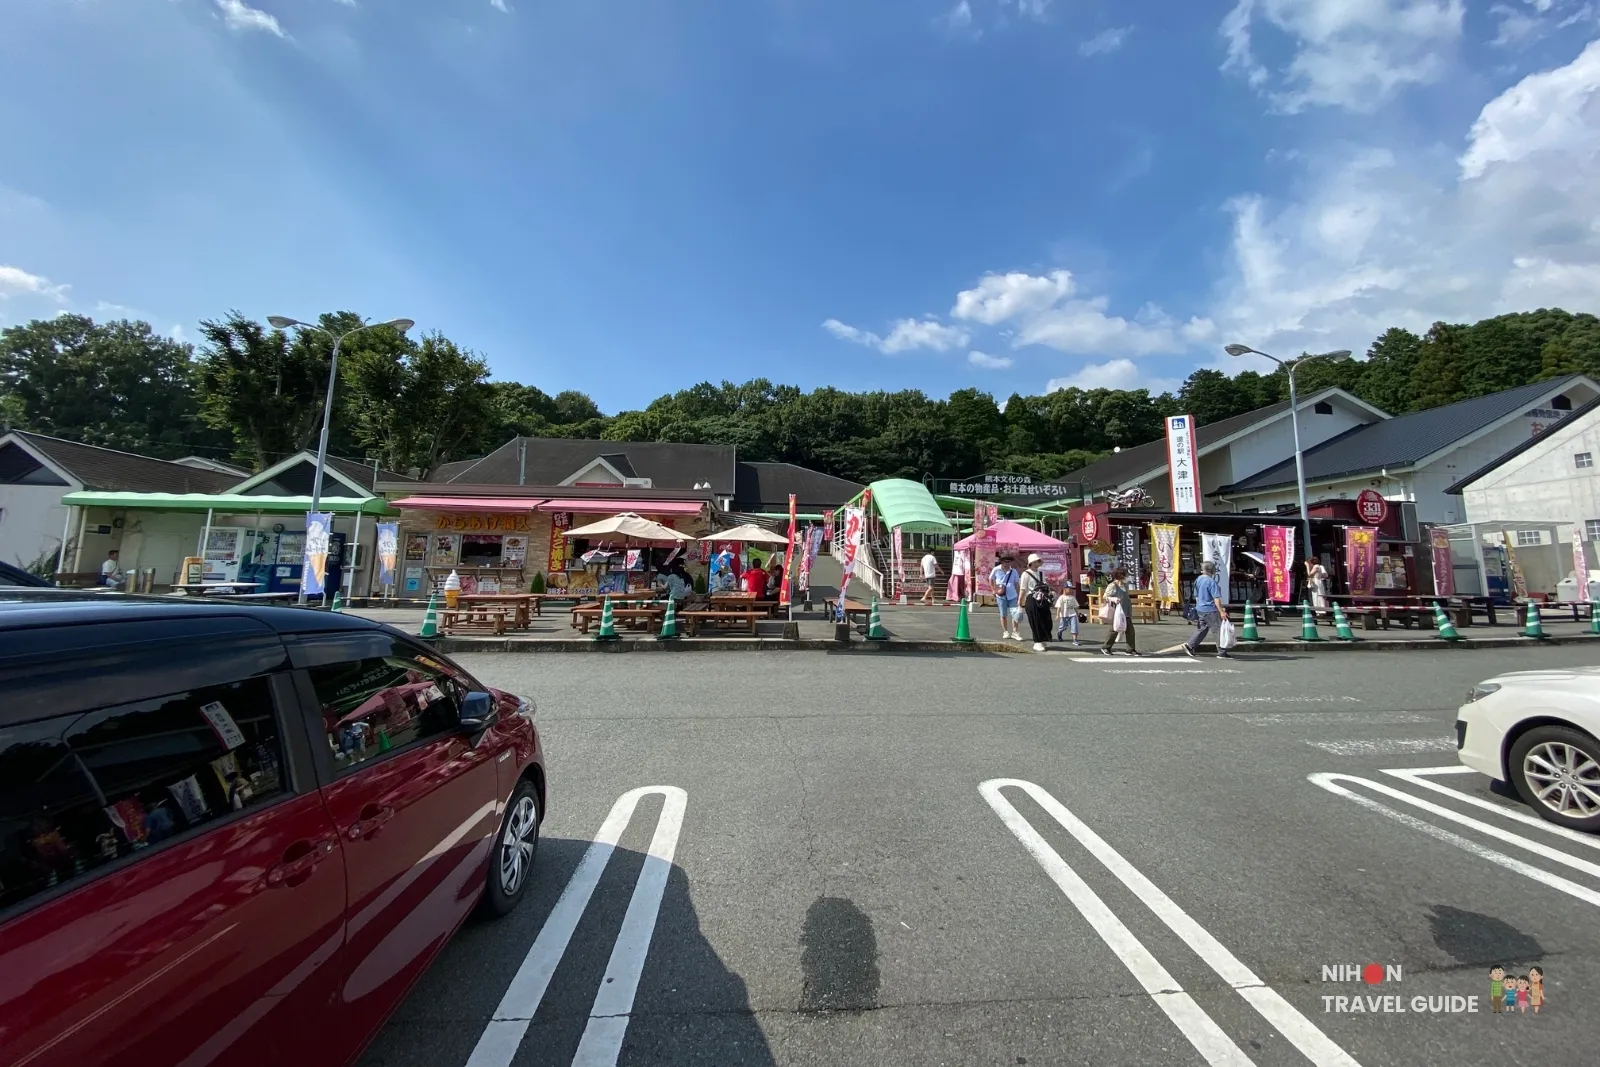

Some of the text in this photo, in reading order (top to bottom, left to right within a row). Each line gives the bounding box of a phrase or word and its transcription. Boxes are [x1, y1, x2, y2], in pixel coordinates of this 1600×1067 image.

[1176, 436, 1189, 480] 道の駅 大津
[949, 482, 1067, 495] 熊本の物産品・お土産せいぞろい
[984, 475, 1032, 484] 熊本文化の森
[1363, 502, 1381, 512] 331
[437, 514, 532, 531] からあげ職人
[550, 528, 565, 571] たこ焼き
[1157, 541, 1173, 584] いも天
[1271, 545, 1284, 599] からいもボール
